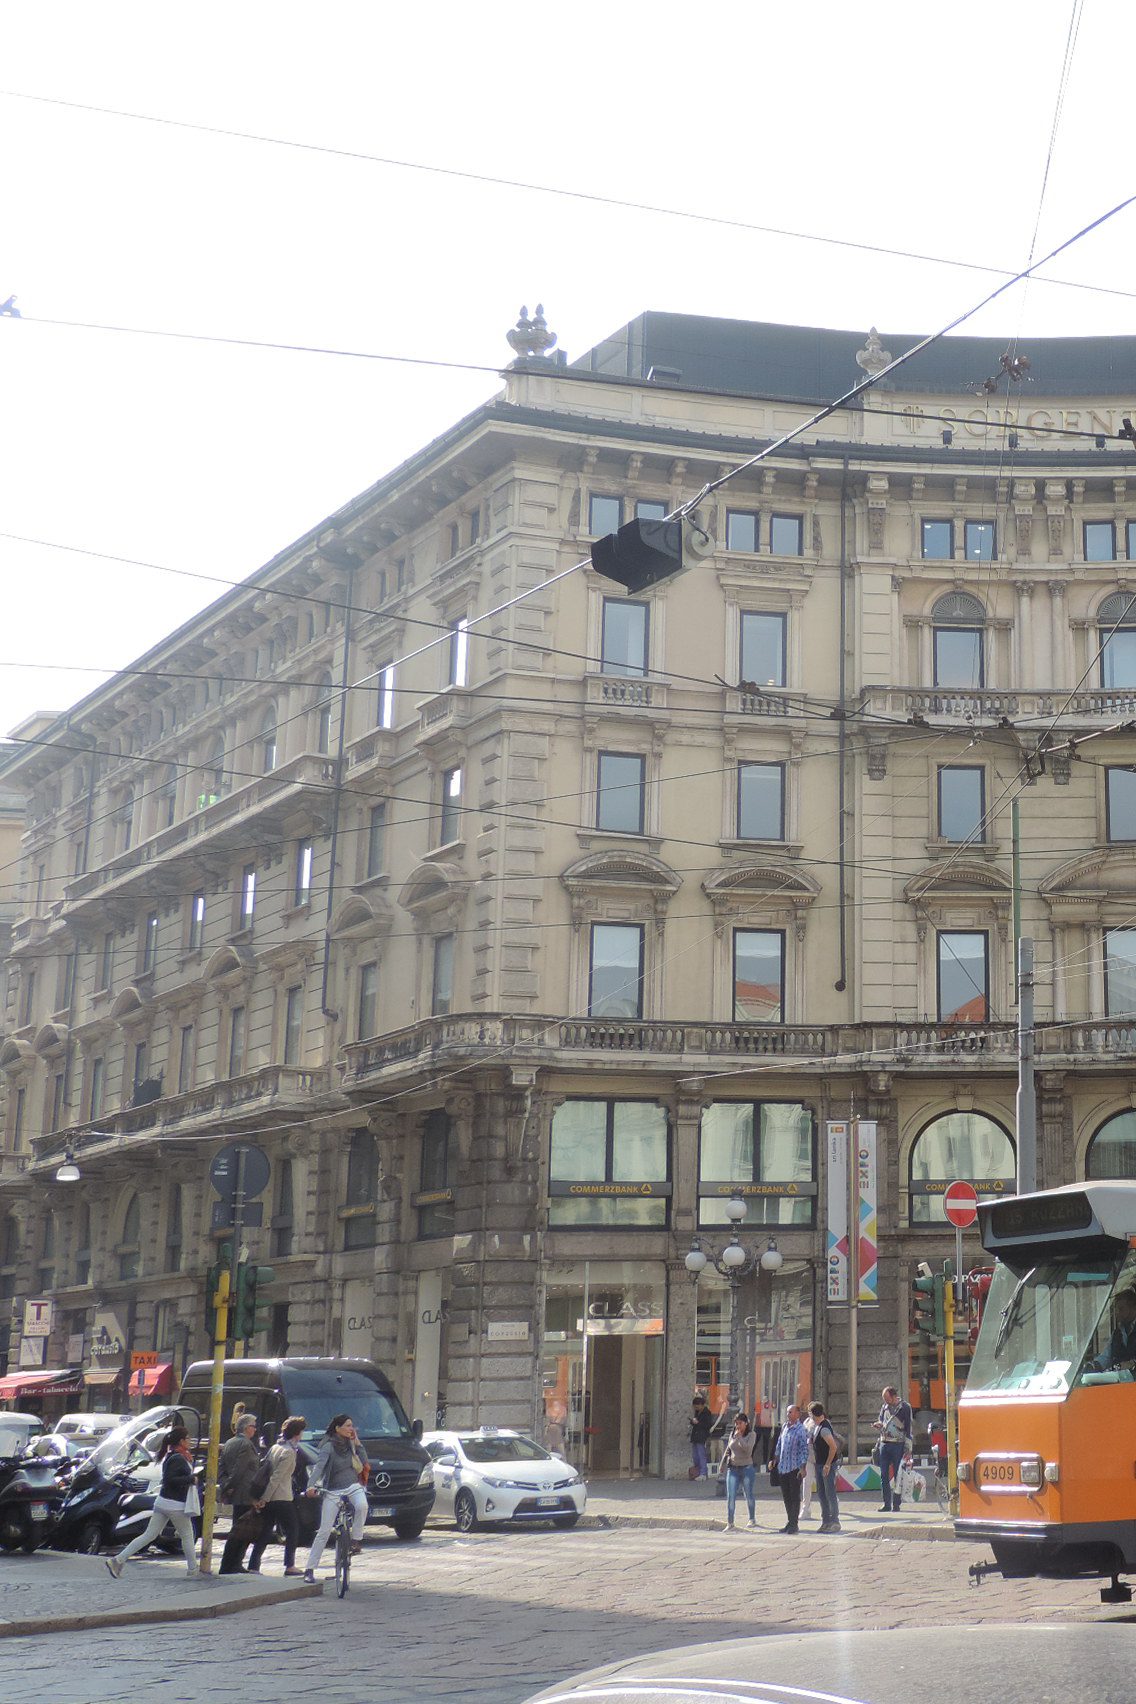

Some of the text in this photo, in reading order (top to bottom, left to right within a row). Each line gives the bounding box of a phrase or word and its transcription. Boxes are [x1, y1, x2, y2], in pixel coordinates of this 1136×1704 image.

[569, 1184, 639, 1194] COMMERZBANK
[925, 1182, 991, 1192] COMANK
[589, 1302, 664, 1318] CLASS
[133, 1355, 157, 1366] TAXI
[983, 1465, 1014, 1480] 4909
